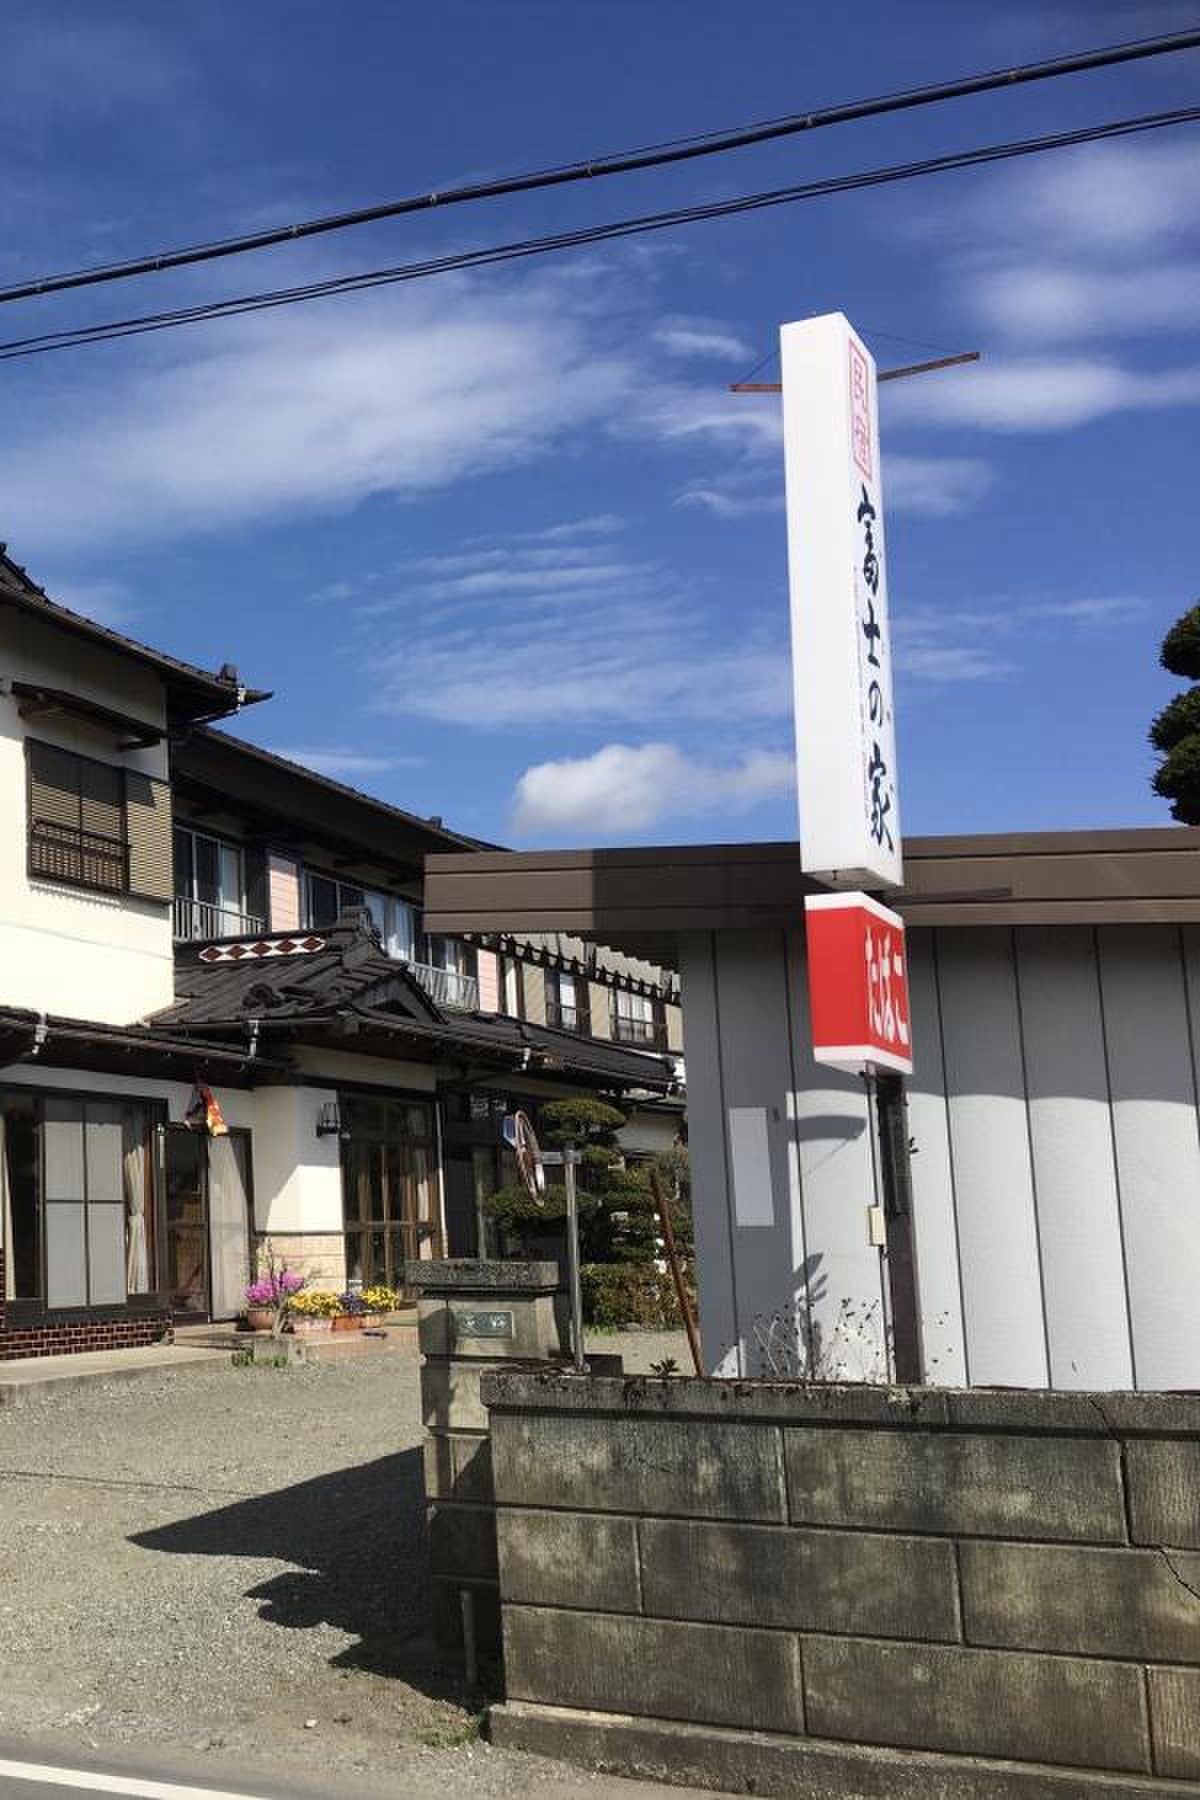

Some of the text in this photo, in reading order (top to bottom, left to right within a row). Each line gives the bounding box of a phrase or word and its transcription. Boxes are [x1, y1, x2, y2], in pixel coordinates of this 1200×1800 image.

[857, 482, 895, 855] 富士の家
[864, 926, 909, 1045] たばこ
